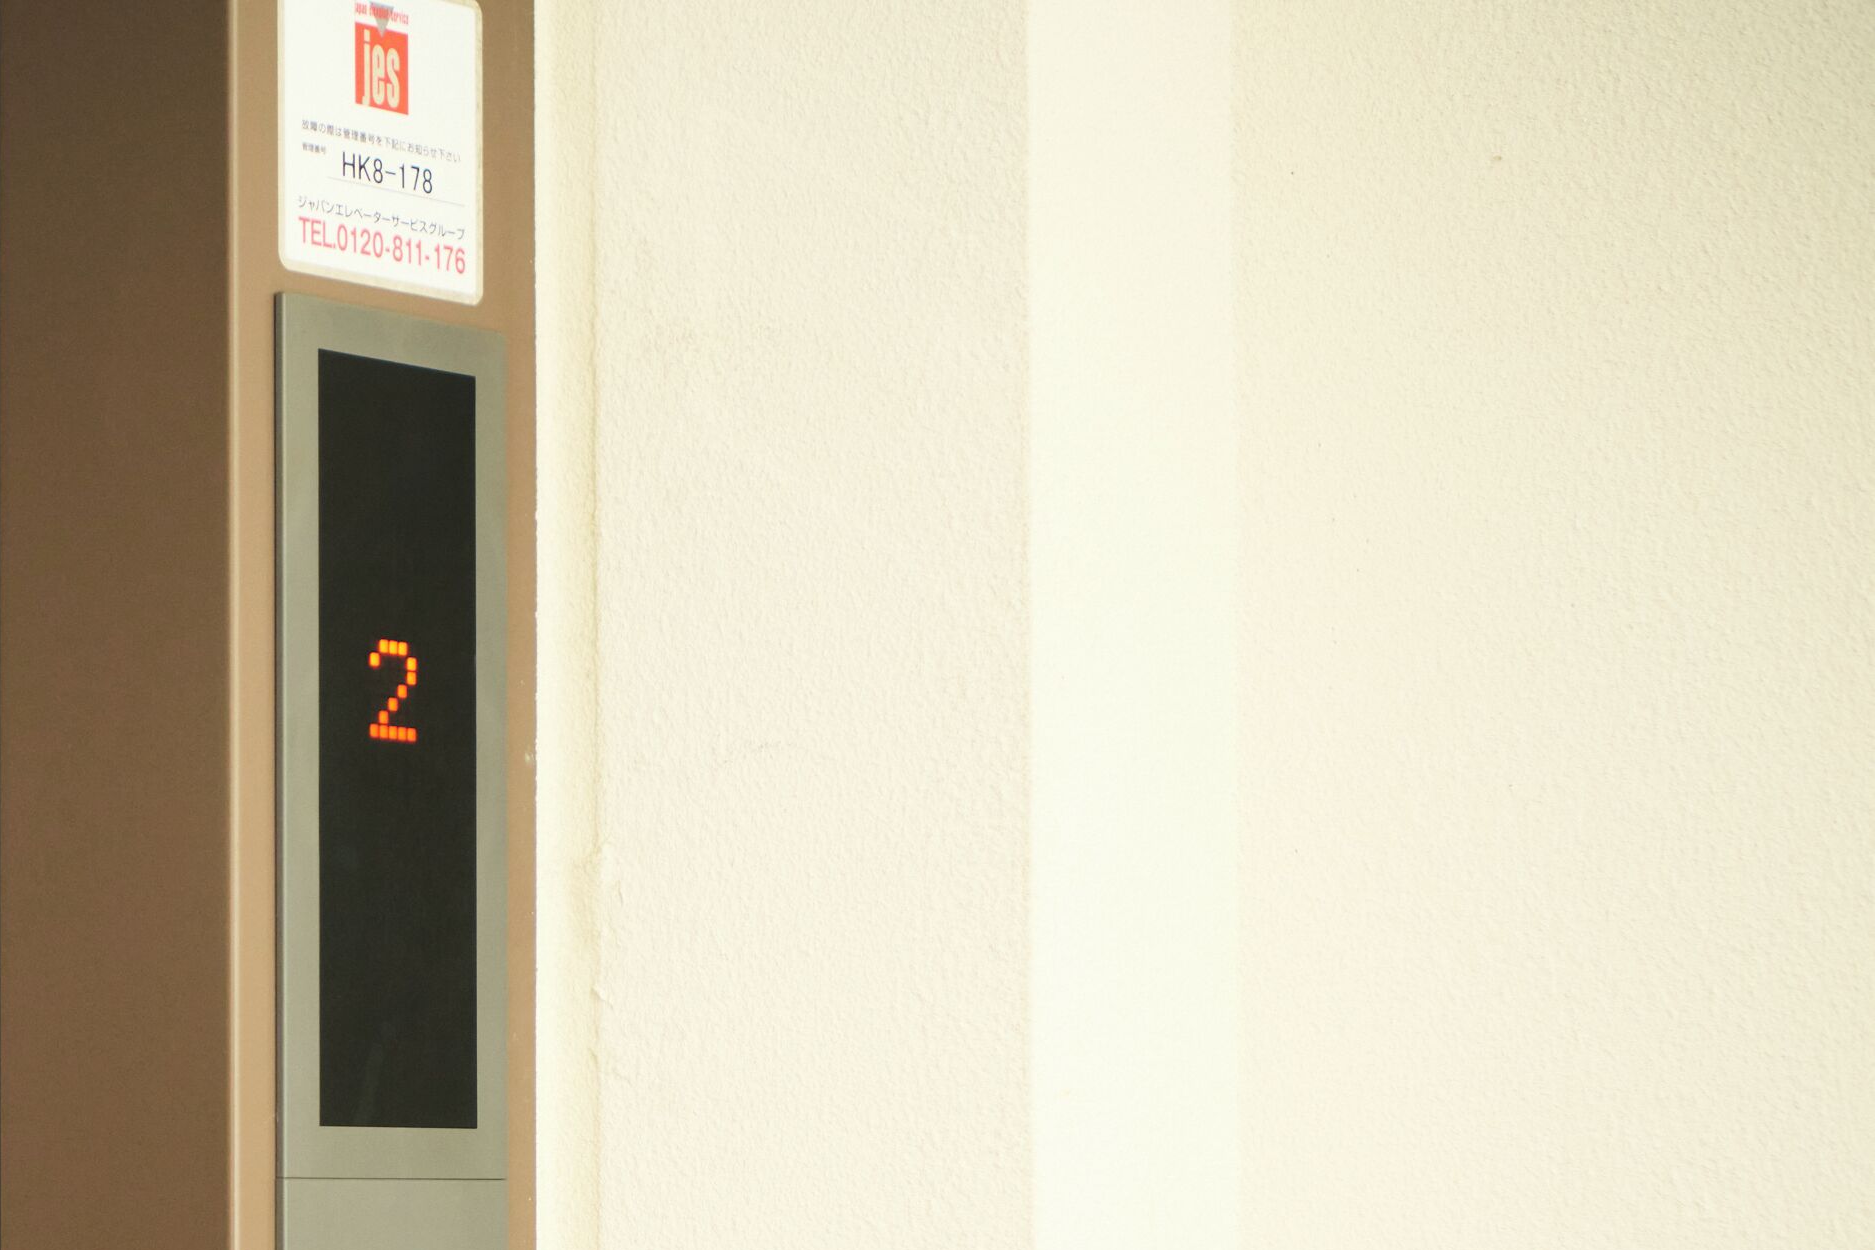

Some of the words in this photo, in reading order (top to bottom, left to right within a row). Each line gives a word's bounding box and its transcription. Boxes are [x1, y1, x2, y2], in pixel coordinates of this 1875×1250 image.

[362, 30, 400, 109] jes
[342, 151, 433, 194] HK8-178
[298, 216, 466, 274] TEL.0120-811-176
[369, 638, 417, 742] 2
